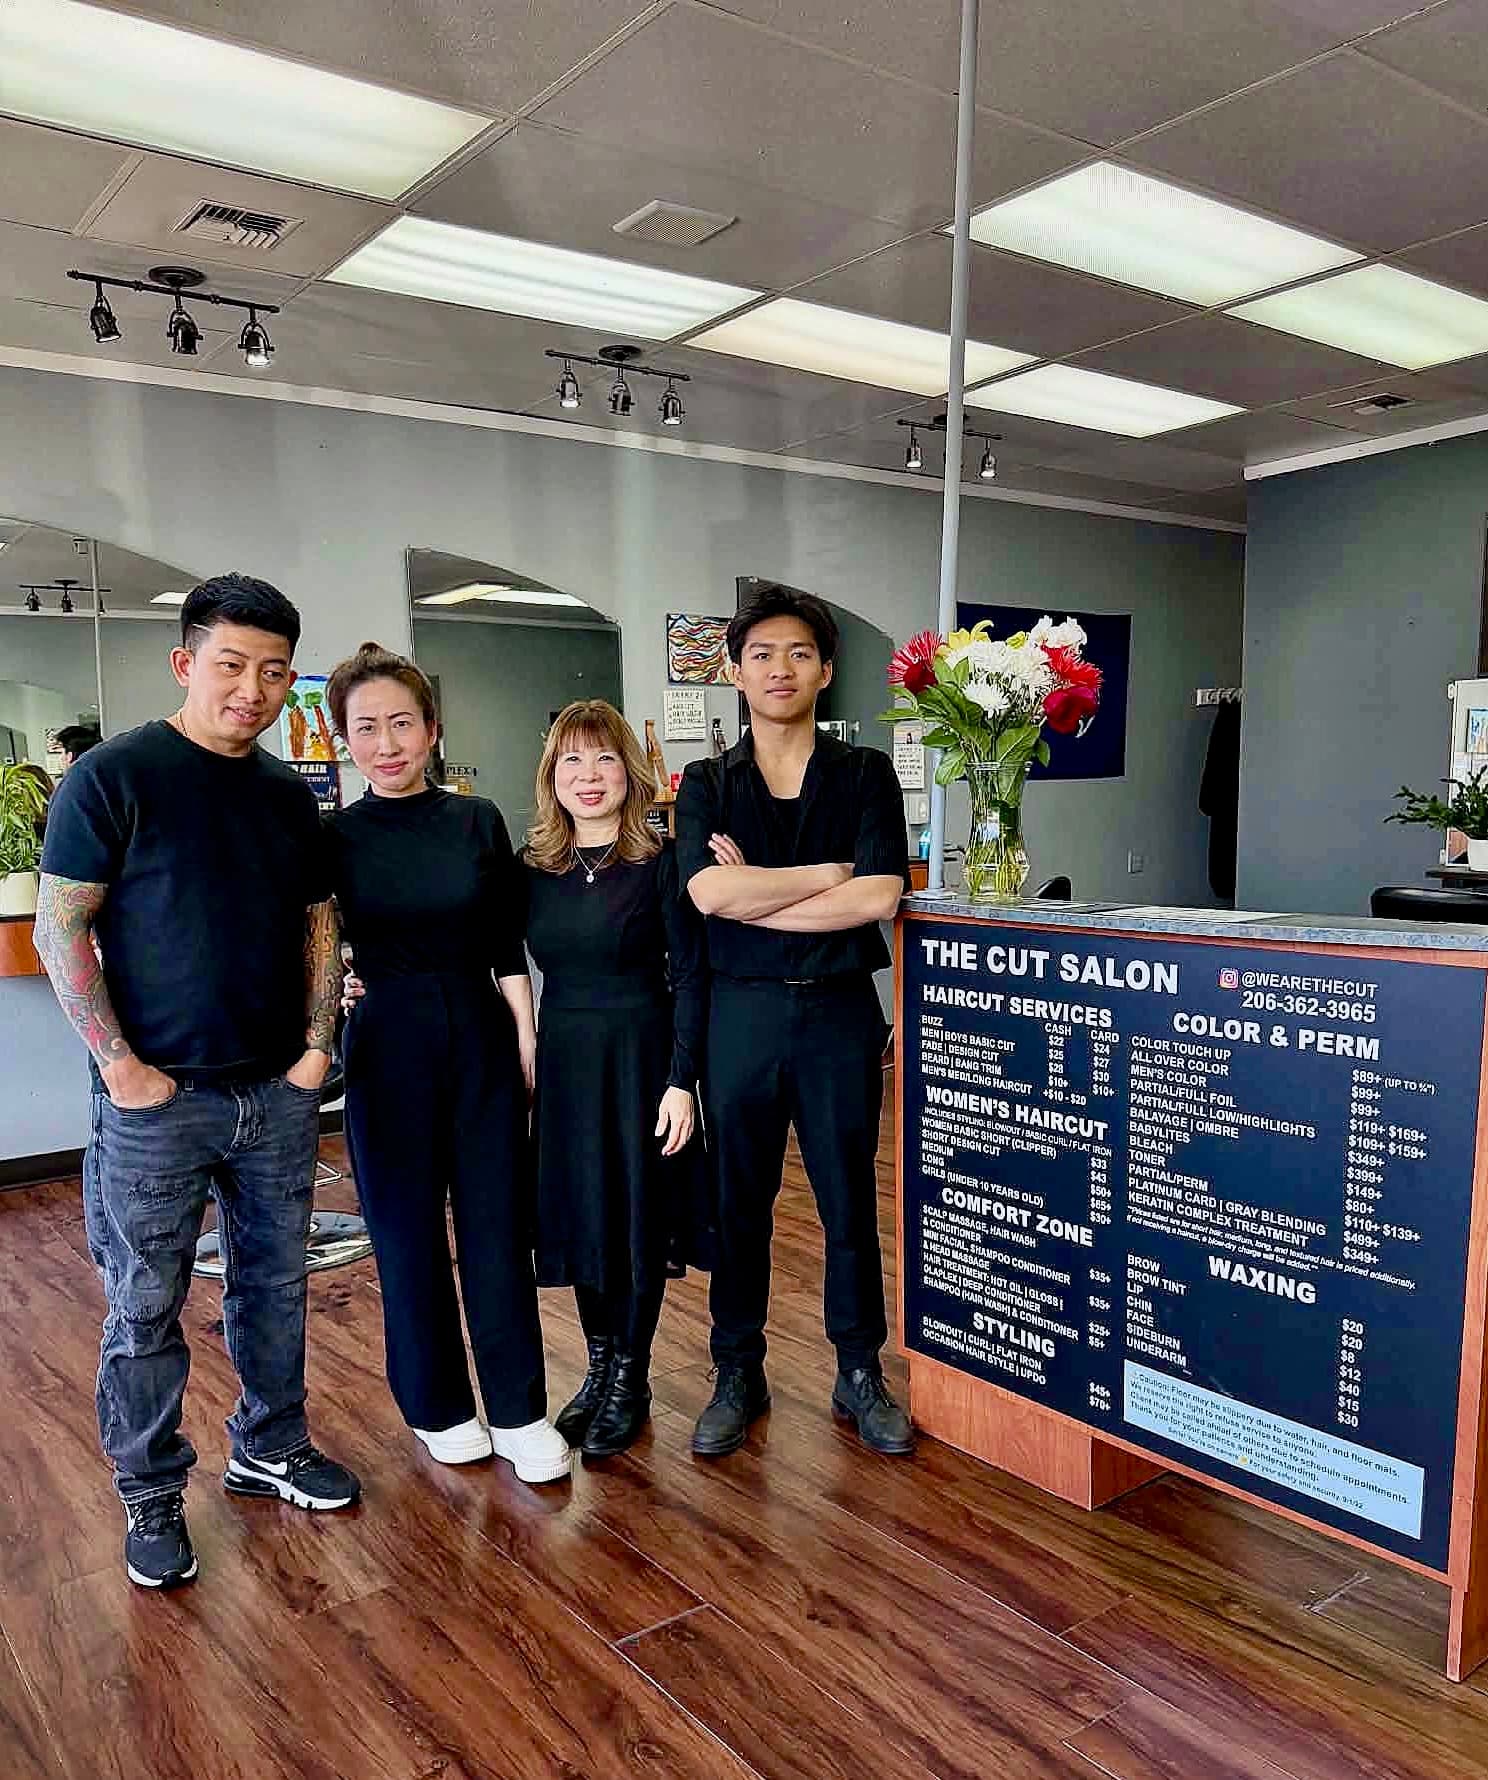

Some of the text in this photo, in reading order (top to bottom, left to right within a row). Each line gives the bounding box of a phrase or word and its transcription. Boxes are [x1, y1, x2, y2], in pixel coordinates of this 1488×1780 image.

[921, 939, 1179, 994] THE CUT SALON
[1241, 971, 1378, 998] @WEARETHECUT
[923, 985, 1112, 1028] HAIRCUT SERVICES
[1240, 991, 1376, 1023] 206-362-3965
[921, 1015, 944, 1027] BUZZ
[921, 1027, 1015, 1051] MEN BOYS BASIC CUT
[1044, 1022, 1120, 1043] CASH CARD
[1173, 1012, 1380, 1060] COLOR & PERM
[922, 1040, 999, 1062] FADE DESIGN CUT
[1048, 1035, 1110, 1055] $22 $24
[1131, 1036, 1231, 1060] COLOR TOUCH UP
[922, 1052, 1001, 1075] BEARD BANG TRIM
[1049, 1048, 1109, 1068] $25 $27
[1131, 1050, 1228, 1076] ALL OVER COLOR
[922, 1064, 1032, 1094] MEN'S MED/LONG HAIRCUT
[1048, 1075, 1114, 1096] $10+ $10+
[1093, 1070, 1109, 1082] $30
[1130, 1064, 1207, 1087] MEN'S COLOR
[1353, 1069, 1381, 1083] $89+
[1071, 1094, 1086, 1105] $20
[1130, 1079, 1236, 1107] PARTIAL/FULL FOIL
[1352, 1085, 1381, 1100] $99+
[926, 1085, 1108, 1140] WOMEN'S HAIRCUT
[1130, 1093, 1316, 1138] PARTIAL/FULL LOW/HIGHLIGHTS
[1351, 1102, 1381, 1116] $99+
[1129, 1122, 1191, 1143] BABYLITES
[1130, 1107, 1239, 1138] BALAYAGE OMBRE
[1350, 1118, 1427, 1141] $119+ $169+
[922, 1117, 1056, 1159] WOMEN BASIC SHORT (CLIPPER)
[922, 1129, 1000, 1156] SHORT DESIGN CUT
[1129, 1135, 1173, 1154] BLEACH
[922, 1141, 953, 1156] MEDIUM
[1129, 1149, 1165, 1166] TONER
[1389, 1142, 1426, 1158] $159+
[922, 1153, 944, 1166] LONG
[1091, 1157, 1106, 1169] $33
[1348, 1151, 1385, 1167] $349+
[1091, 1171, 1106, 1183] $43
[1129, 1163, 1208, 1191] PARTIAL/PERM
[1347, 1166, 1384, 1183] $399+
[922, 1165, 1044, 1208] GIRLS (UNDER YEARS OLD)
[1090, 1184, 1111, 1197] $50+
[1346, 1183, 1382, 1199] $149+
[1129, 1177, 1327, 1236] PLATINUM CARD GRAY BLENDING
[1345, 1199, 1375, 1214] $80+
[923, 1204, 1035, 1247] SCALP HAIR WASH
[942, 1188, 1093, 1247] COMFORT ZONE
[1090, 1211, 1111, 1224] $30+
[1129, 1191, 1309, 1247] KERATIN COMPLEX TREATMENT
[930, 1219, 981, 1243] CONDITIONER
[1345, 1215, 1420, 1241] $110+ $139+
[1344, 1230, 1380, 1248] $499+
[930, 1242, 950, 1257] HEAD
[1343, 1246, 1379, 1264] $349+
[970, 1244, 1070, 1285] SHAMPOO CONDITIONER
[1128, 1254, 1160, 1272] BROW
[923, 1251, 941, 1265] HAIR
[991, 1275, 1007, 1288] HOT
[1009, 1281, 1023, 1295] OIL
[1029, 1288, 1058, 1306] GLOSS
[1089, 1268, 1111, 1283] $35+
[1127, 1268, 1186, 1295] BROW TINT
[1208, 1256, 1316, 1304] WAXING
[963, 1278, 1040, 1313] DEEP CONDITIONER
[1127, 1282, 1143, 1294] LIP
[924, 1276, 1078, 1341] SHAMPOO CONDITIONER
[1089, 1295, 1110, 1310] $35+
[1127, 1296, 1152, 1312] CHIN
[1127, 1309, 1153, 1327] FACE
[1342, 1319, 1363, 1334] $20
[973, 1312, 1055, 1357] STYLING
[1089, 1322, 1110, 1337] $25+
[1127, 1323, 1180, 1350] SIDEBURN
[923, 1316, 1041, 1370] BLOWOUT CURL FLAT IRON
[1089, 1336, 1105, 1348] $5+
[1127, 1336, 1186, 1366] UNDERARM
[1342, 1334, 1362, 1350] $20
[923, 1329, 1046, 1384] OCCASION HAIR STYLE UPDO
[1341, 1350, 1354, 1363] $8
[1340, 1365, 1360, 1381] $12
[1089, 1382, 1110, 1397] $45+
[1339, 1380, 1359, 1397] $40
[1089, 1395, 1111, 1411] $70+
[1339, 1396, 1359, 1411] $15
[1338, 1411, 1358, 1427] $30
